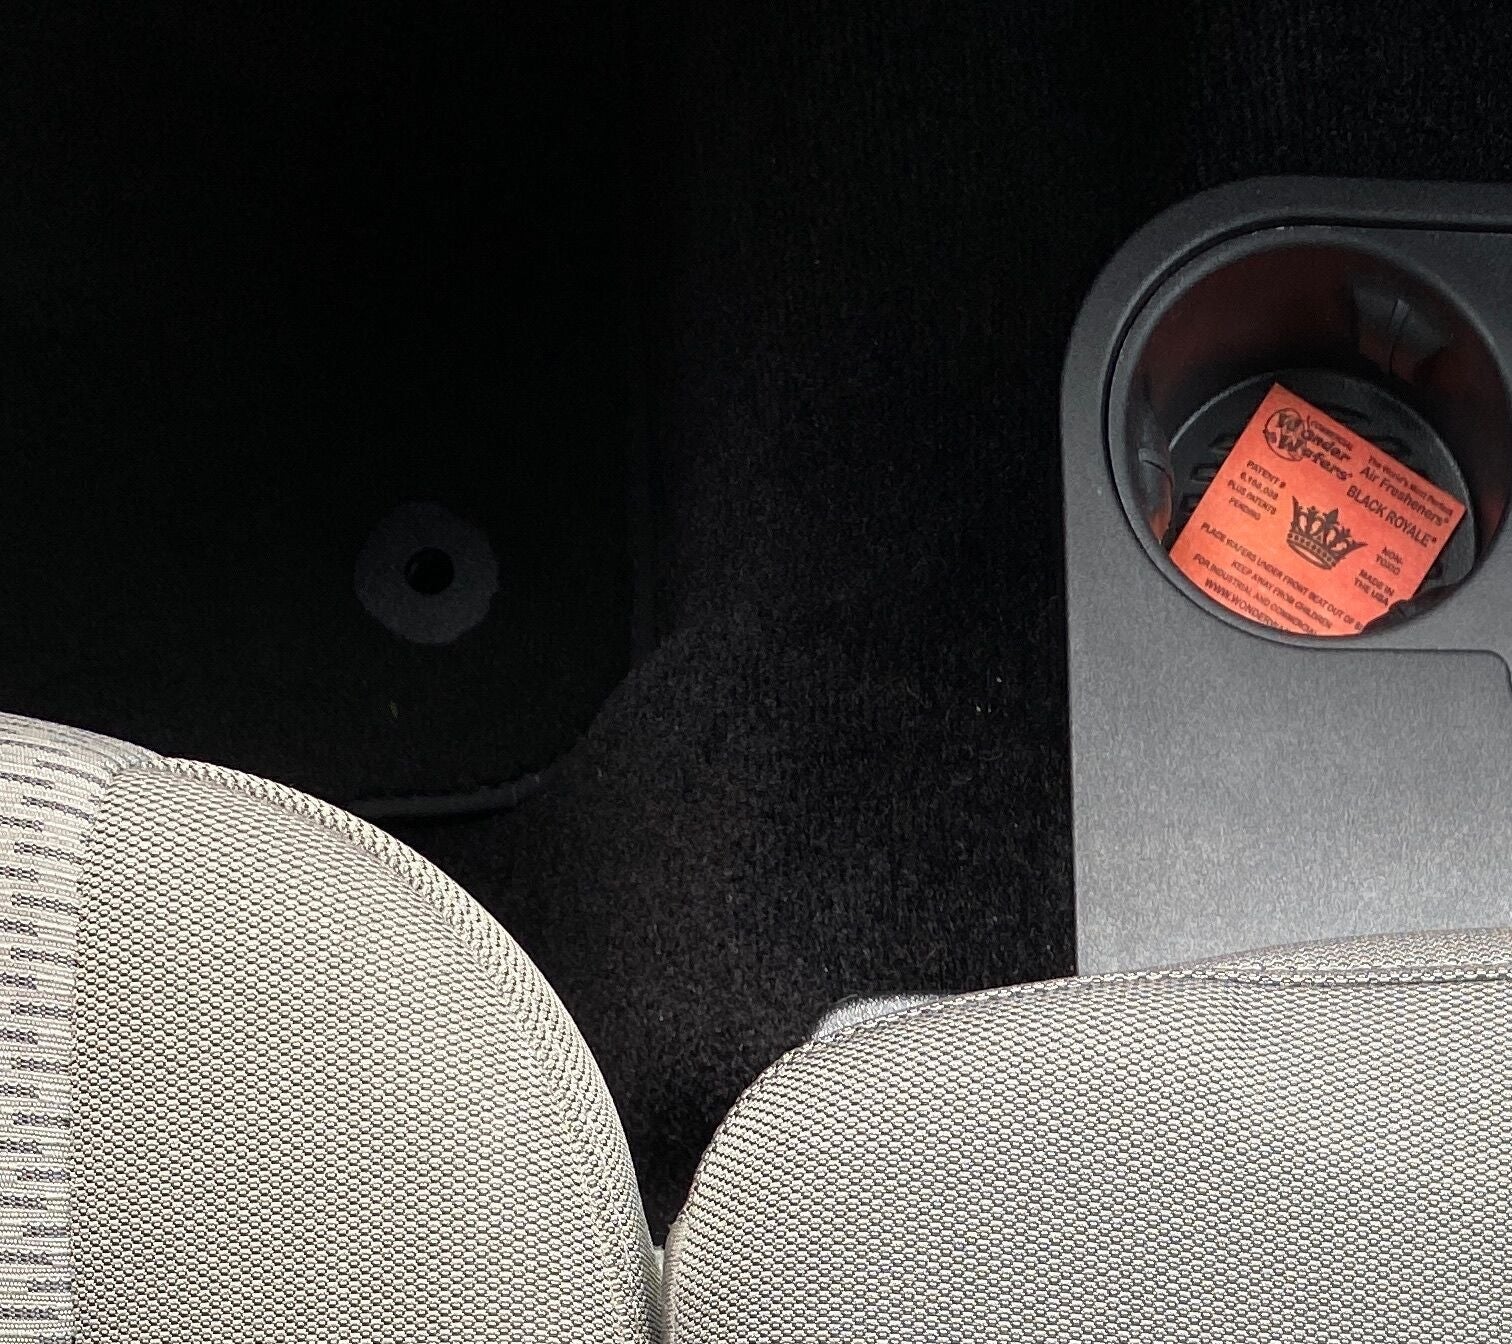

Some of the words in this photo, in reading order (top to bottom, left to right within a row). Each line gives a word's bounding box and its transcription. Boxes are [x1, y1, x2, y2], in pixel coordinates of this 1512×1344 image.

[1246, 459, 1280, 484] PATENT
[1359, 465, 1379, 482] Air
[1227, 479, 1246, 495] PLUS
[1246, 491, 1276, 514] PATENTS
[1228, 496, 1260, 520] PENDING
[1346, 484, 1387, 518] BLACK
[1192, 553, 1210, 568] FOR
[1208, 563, 1251, 595] INDUSTRIAL
[1252, 591, 1270, 606] AND
[1200, 521, 1226, 542] PLACE
[1256, 557, 1283, 579] UNDER
[1282, 575, 1308, 595] FRONT
[1326, 603, 1344, 618] OUT
[1343, 614, 1354, 624] OF
[1358, 569, 1384, 589] MADE
[1383, 585, 1394, 596] IN
[1230, 559, 1252, 575] KEEP
[1250, 573, 1272, 590] AWAY
[1272, 587, 1295, 604] FROM
[1294, 601, 1332, 629] CHILDREN
[1354, 577, 1371, 594] THE
[1370, 589, 1388, 606] USA
